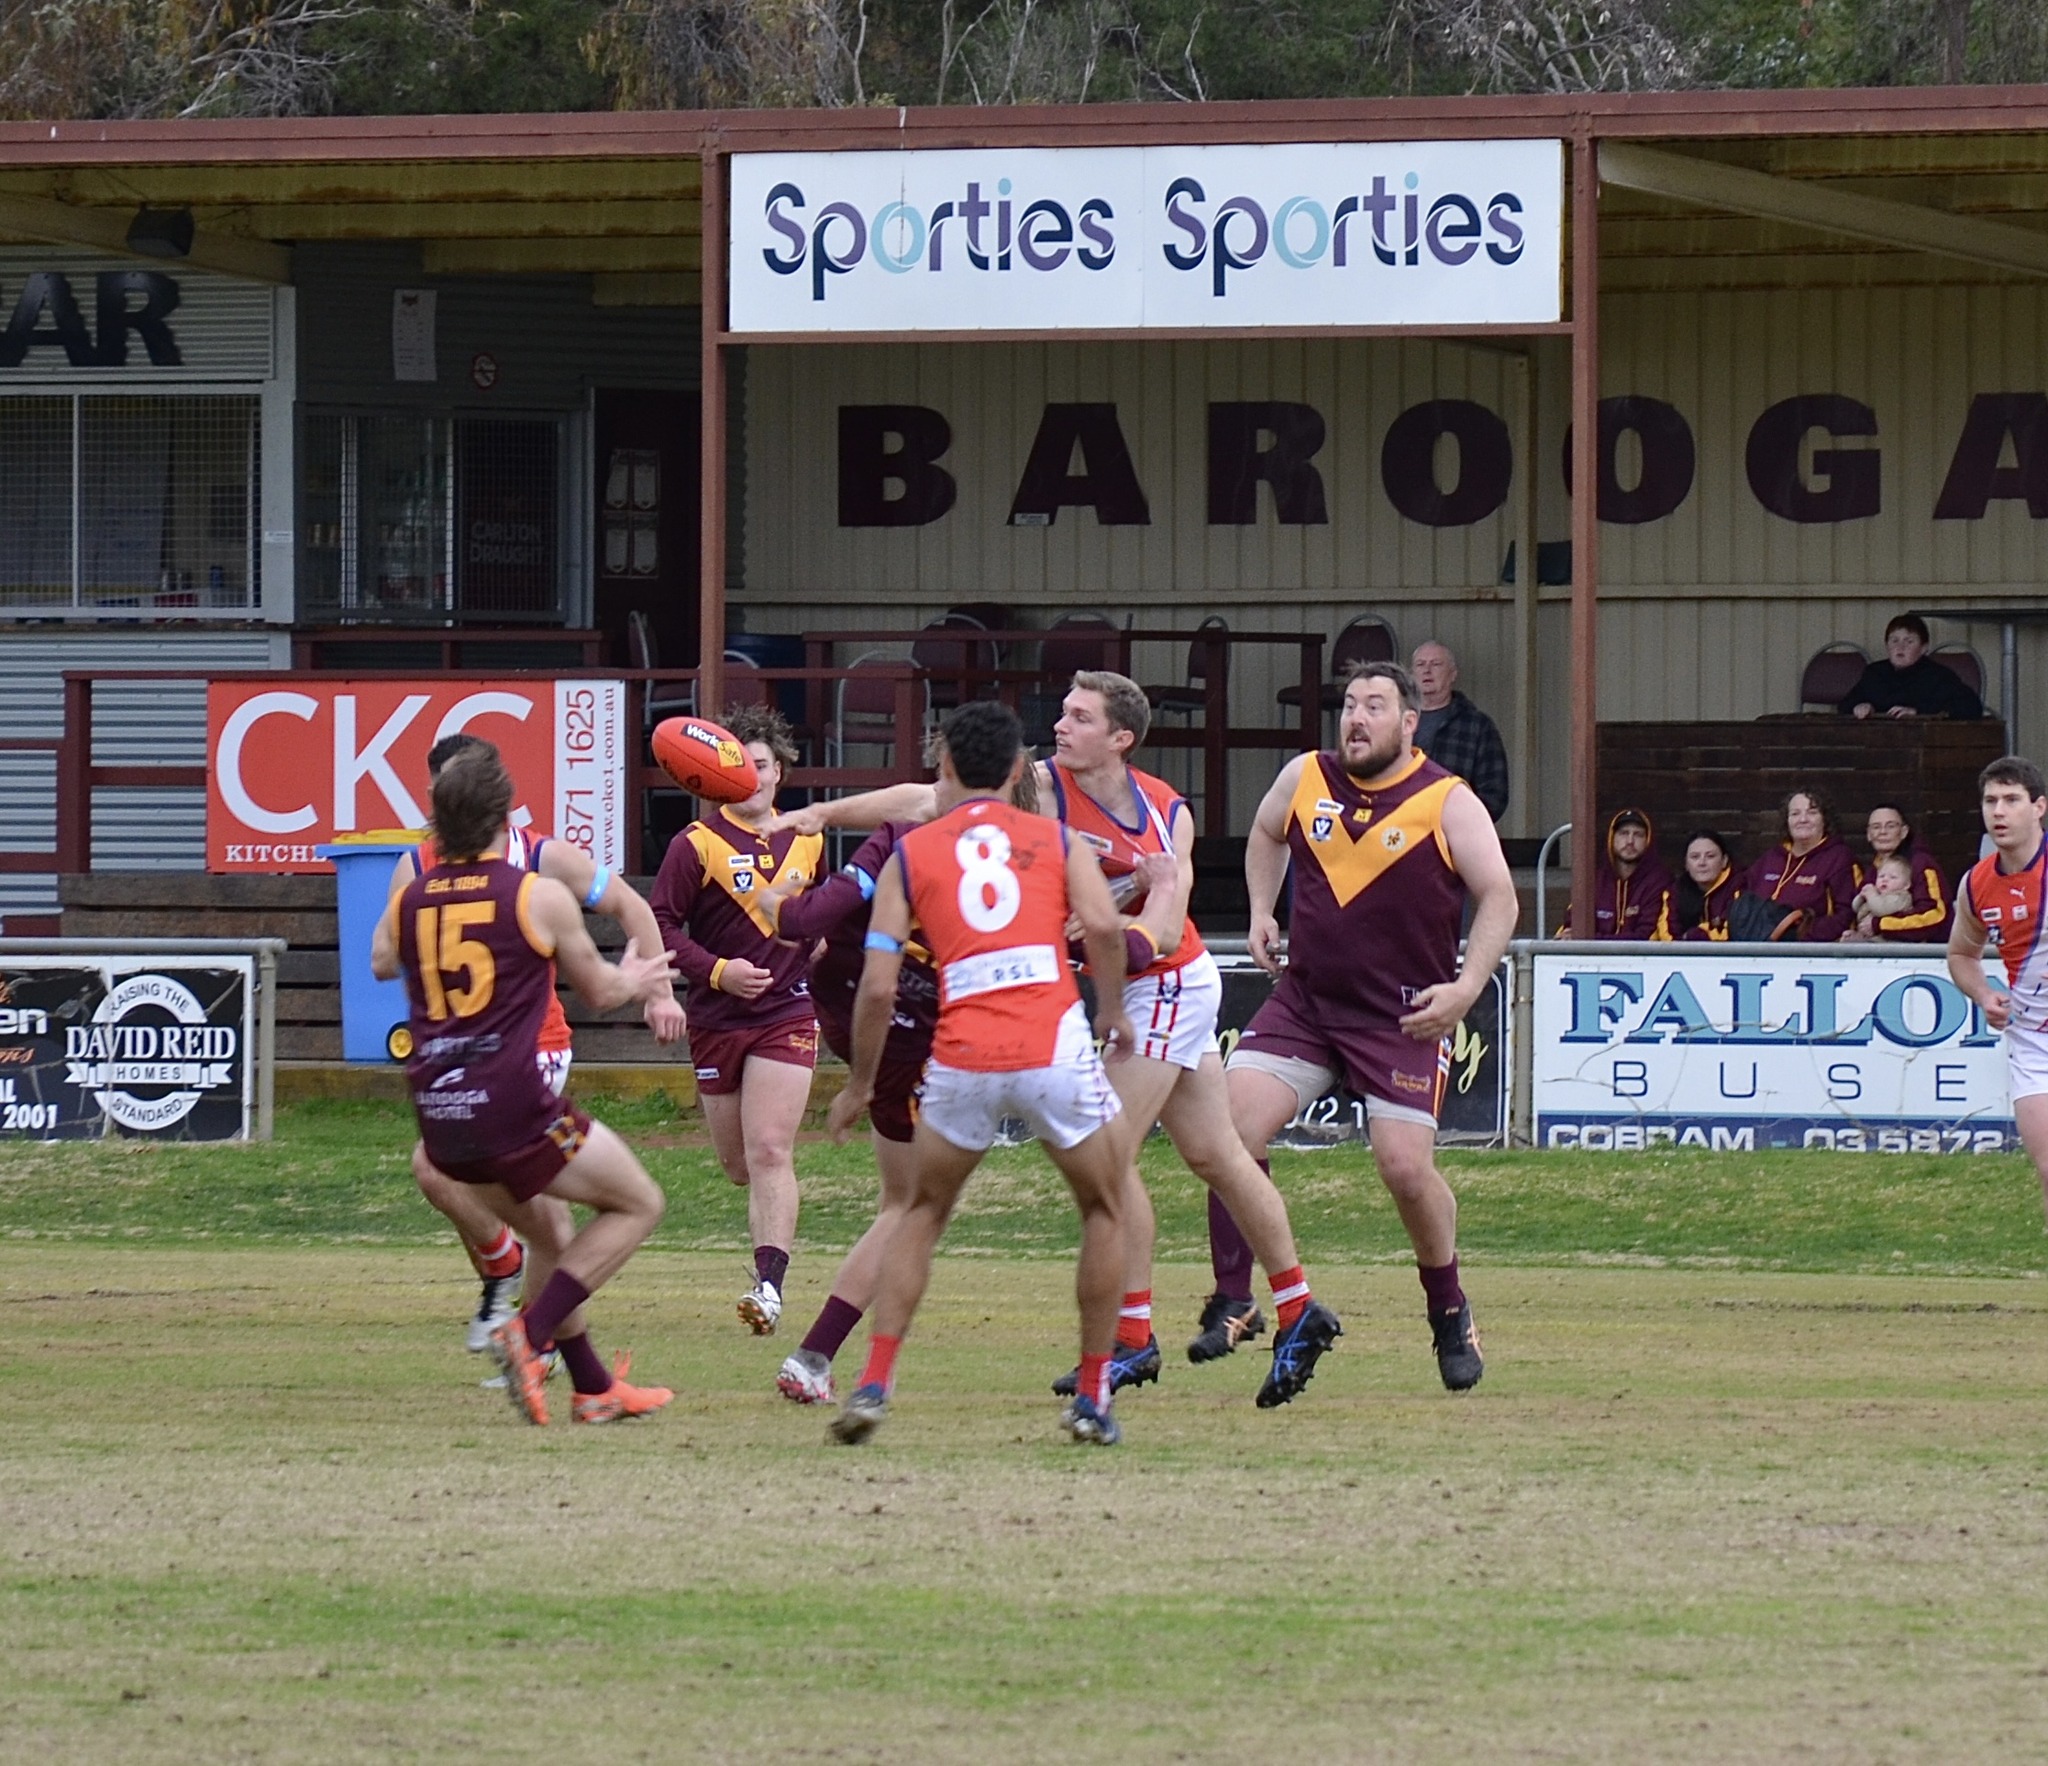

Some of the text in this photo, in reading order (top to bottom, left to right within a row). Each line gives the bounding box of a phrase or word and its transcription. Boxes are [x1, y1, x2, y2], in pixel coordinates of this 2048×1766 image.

[763, 171, 1525, 302] Sporties Sporties
[0, 271, 185, 367] AR
[838, 392, 2048, 527] BAROOGA
[565, 689, 595, 770] 1625
[687, 724, 742, 764] Work Safe
[955, 824, 1021, 933] 8
[416, 901, 496, 1021] 15
[993, 963, 1038, 983] RSL
[109, 982, 191, 1016] RAISING THE
[64, 1026, 237, 1060] DAVID REID
[116, 1066, 182, 1081] HOMES
[2, 1104, 59, 1130] 2001
[111, 1098, 183, 1123] STANDARD
[1548, 1125, 2004, 1155] COBRAM 03 5872
